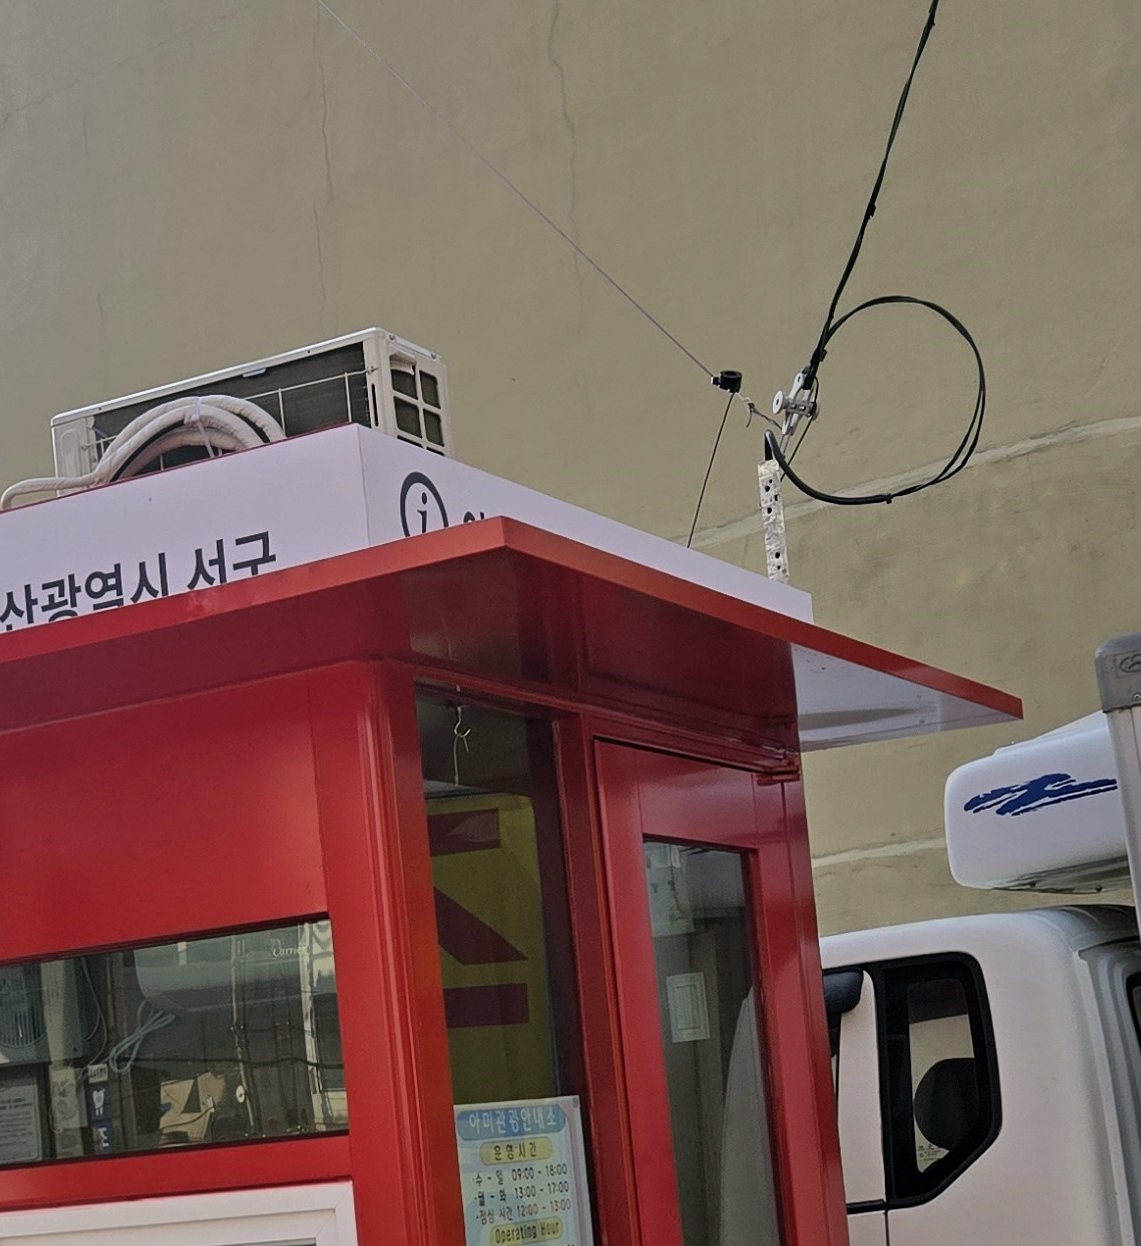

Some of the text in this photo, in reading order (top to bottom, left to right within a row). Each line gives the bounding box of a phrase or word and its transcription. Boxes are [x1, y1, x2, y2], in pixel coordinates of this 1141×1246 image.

[187, 530, 277, 590] 서구
[469, 1107, 556, 1134] 아미관광안내소
[512, 1167, 534, 1181] 09:00
[545, 1163, 567, 1177] 18:00
[514, 1185, 536, 1199] 13:00
[547, 1181, 569, 1194] 17:00
[517, 1203, 538, 1217] 12:00
[550, 1198, 571, 1212] 13:00
[495, 1222, 559, 1244] Operating Hour
